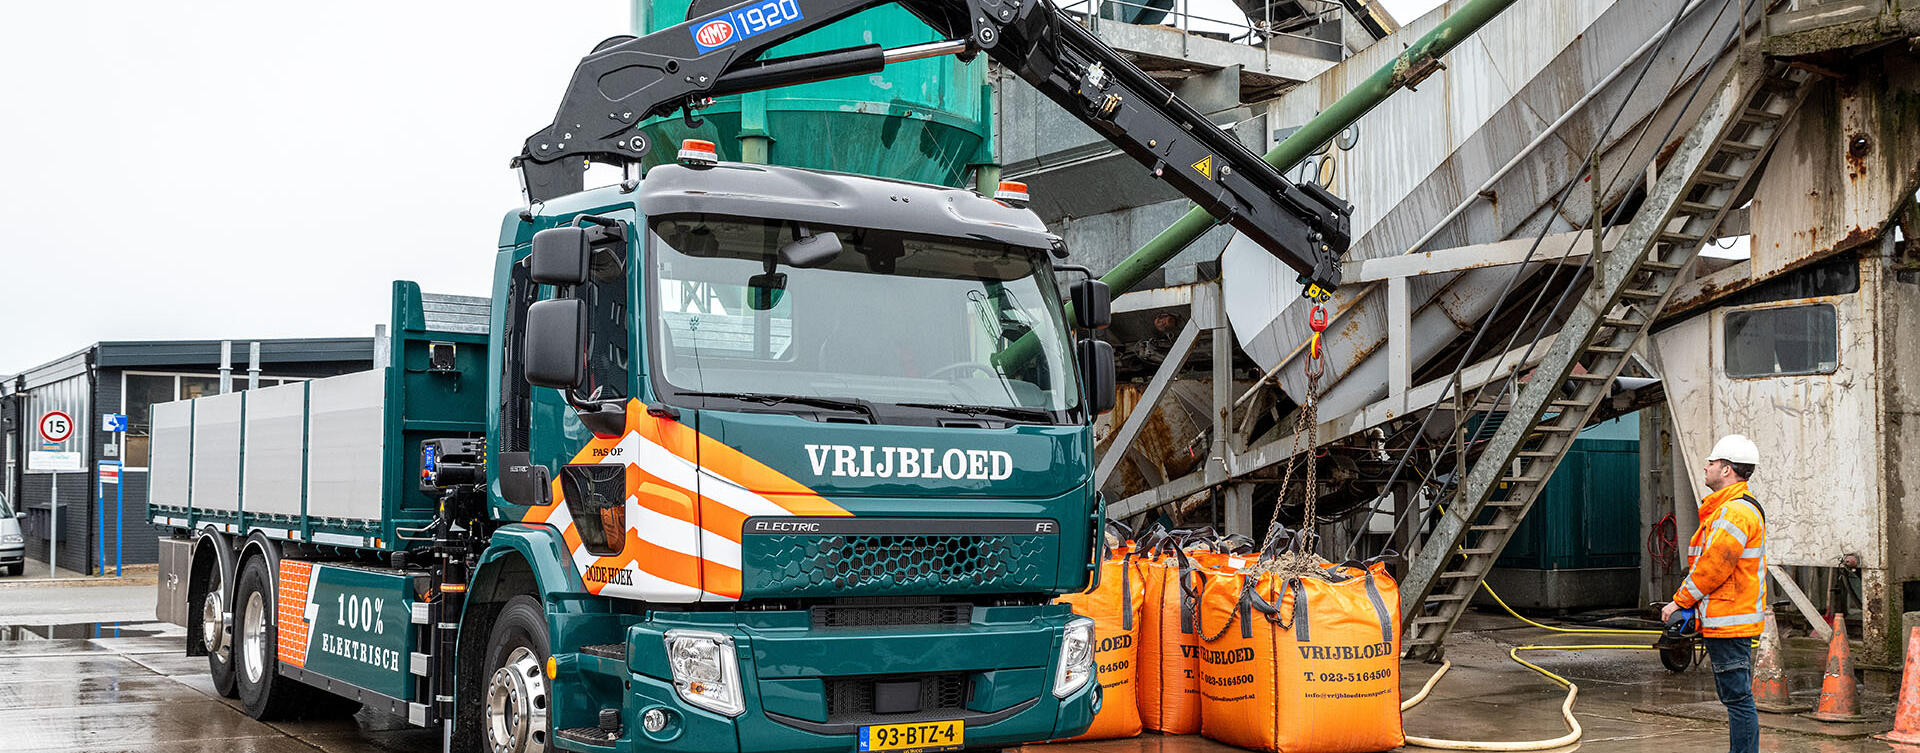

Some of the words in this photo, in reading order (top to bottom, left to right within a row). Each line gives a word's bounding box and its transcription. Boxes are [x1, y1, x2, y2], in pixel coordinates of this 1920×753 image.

[700, 23, 728, 44] HMF
[737, 0, 799, 35] 1920
[49, 420, 66, 434] 15
[592, 448, 609, 457] PAS
[610, 447, 624, 456] OP
[805, 444, 1013, 480] VRIJBLOED
[755, 521, 820, 532] ELECTRIC
[1035, 522, 1053, 532] FE
[585, 565, 607, 583] DODE
[608, 567, 633, 586] HOEK
[337, 593, 385, 635] 100%
[322, 633, 400, 672] ELEKTRISCH
[1298, 642, 1392, 660] VRIJBLOED
[1304, 672, 1316, 682] T.
[1320, 668, 1391, 682] 023-5164500
[876, 724, 955, 747] 93-BTZ-4
